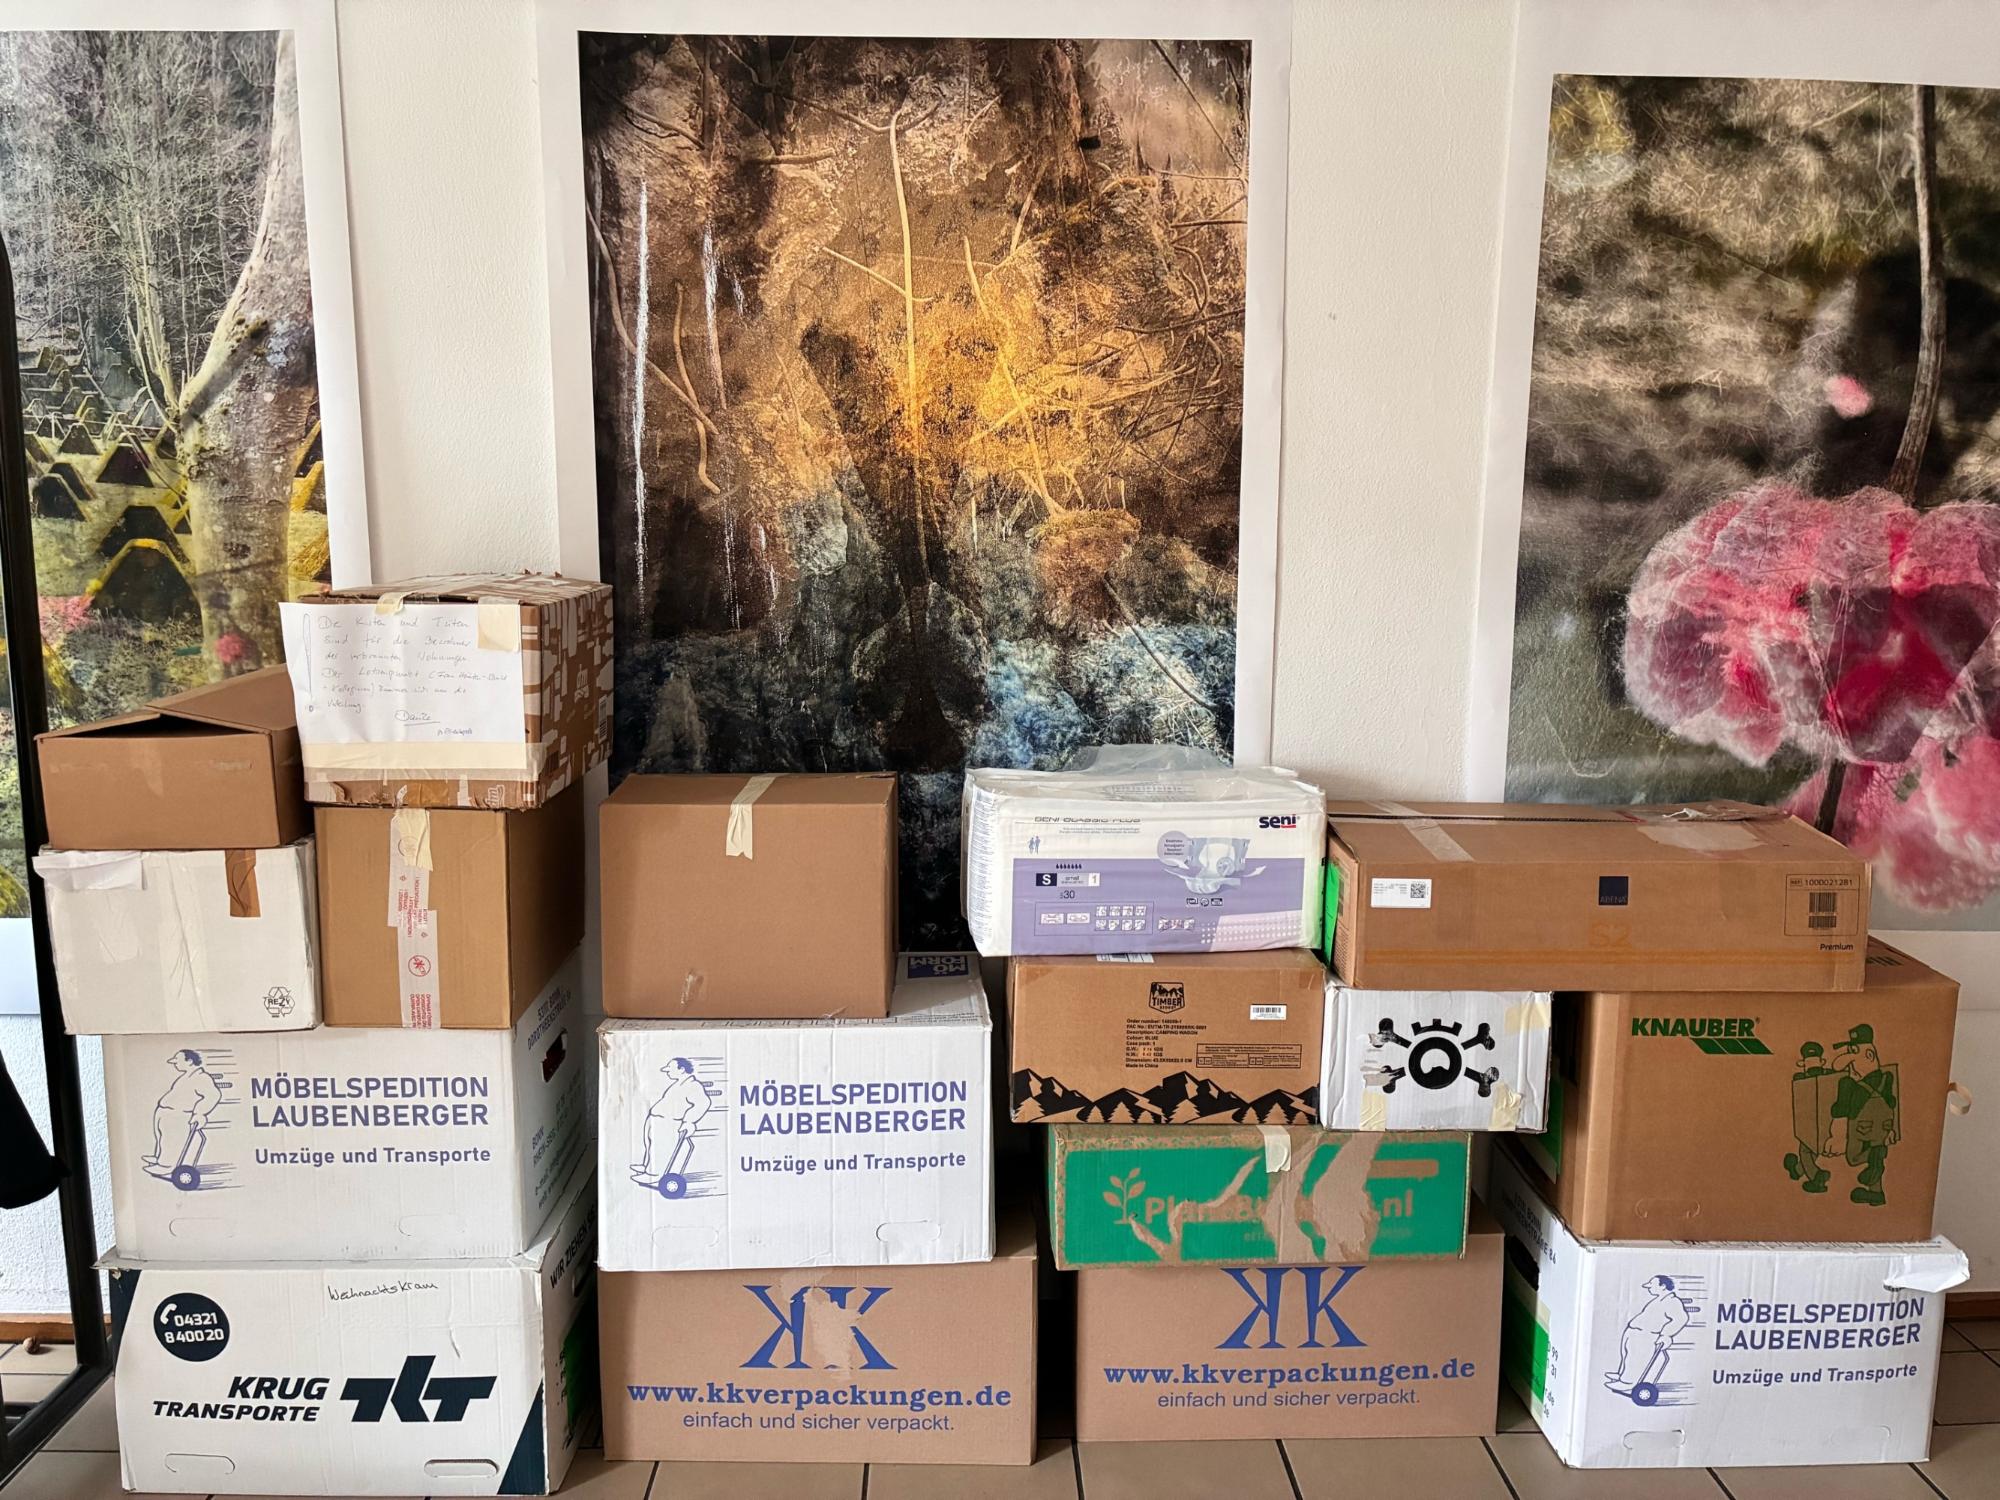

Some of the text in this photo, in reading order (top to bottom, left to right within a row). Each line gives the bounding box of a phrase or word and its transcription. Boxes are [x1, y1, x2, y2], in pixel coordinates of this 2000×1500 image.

[1259, 814, 1297, 829] seni
[1042, 874, 1051, 885] S
[1063, 890, 1075, 899] 30
[1820, 943, 1853, 951] Premium
[1152, 998, 1182, 1006] TIMBER
[1632, 1018, 1755, 1036] KNAUBER
[251, 1072, 488, 1099] MÖBELSPEDITION
[740, 1080, 967, 1106] MÖBELSPEDITION
[252, 1104, 489, 1128] LAUBENBERGER
[740, 1108, 966, 1135] LAUBENBERGER
[255, 1147, 491, 1167] Umzüge und Transporte
[740, 1152, 966, 1175] Umzüge und Transporte
[550, 1259, 565, 1289] WIR
[174, 1312, 218, 1327] 04321
[1717, 1297, 1924, 1324] MÖBELSPEDITION
[1715, 1323, 1920, 1350] LAUBENBERGER
[1103, 1359, 1475, 1389] www.kkverpackungen.de
[1712, 1364, 1918, 1386] Umzüge und Transporte
[228, 1376, 330, 1400] KRUG
[627, 1382, 1011, 1411] www.kkverpackungen.de
[1158, 1389, 1420, 1408] einfach und sicher verpackt.
[153, 1400, 320, 1422] TRANSPORTE
[683, 1412, 954, 1433] einfach und sicher verpackt.
